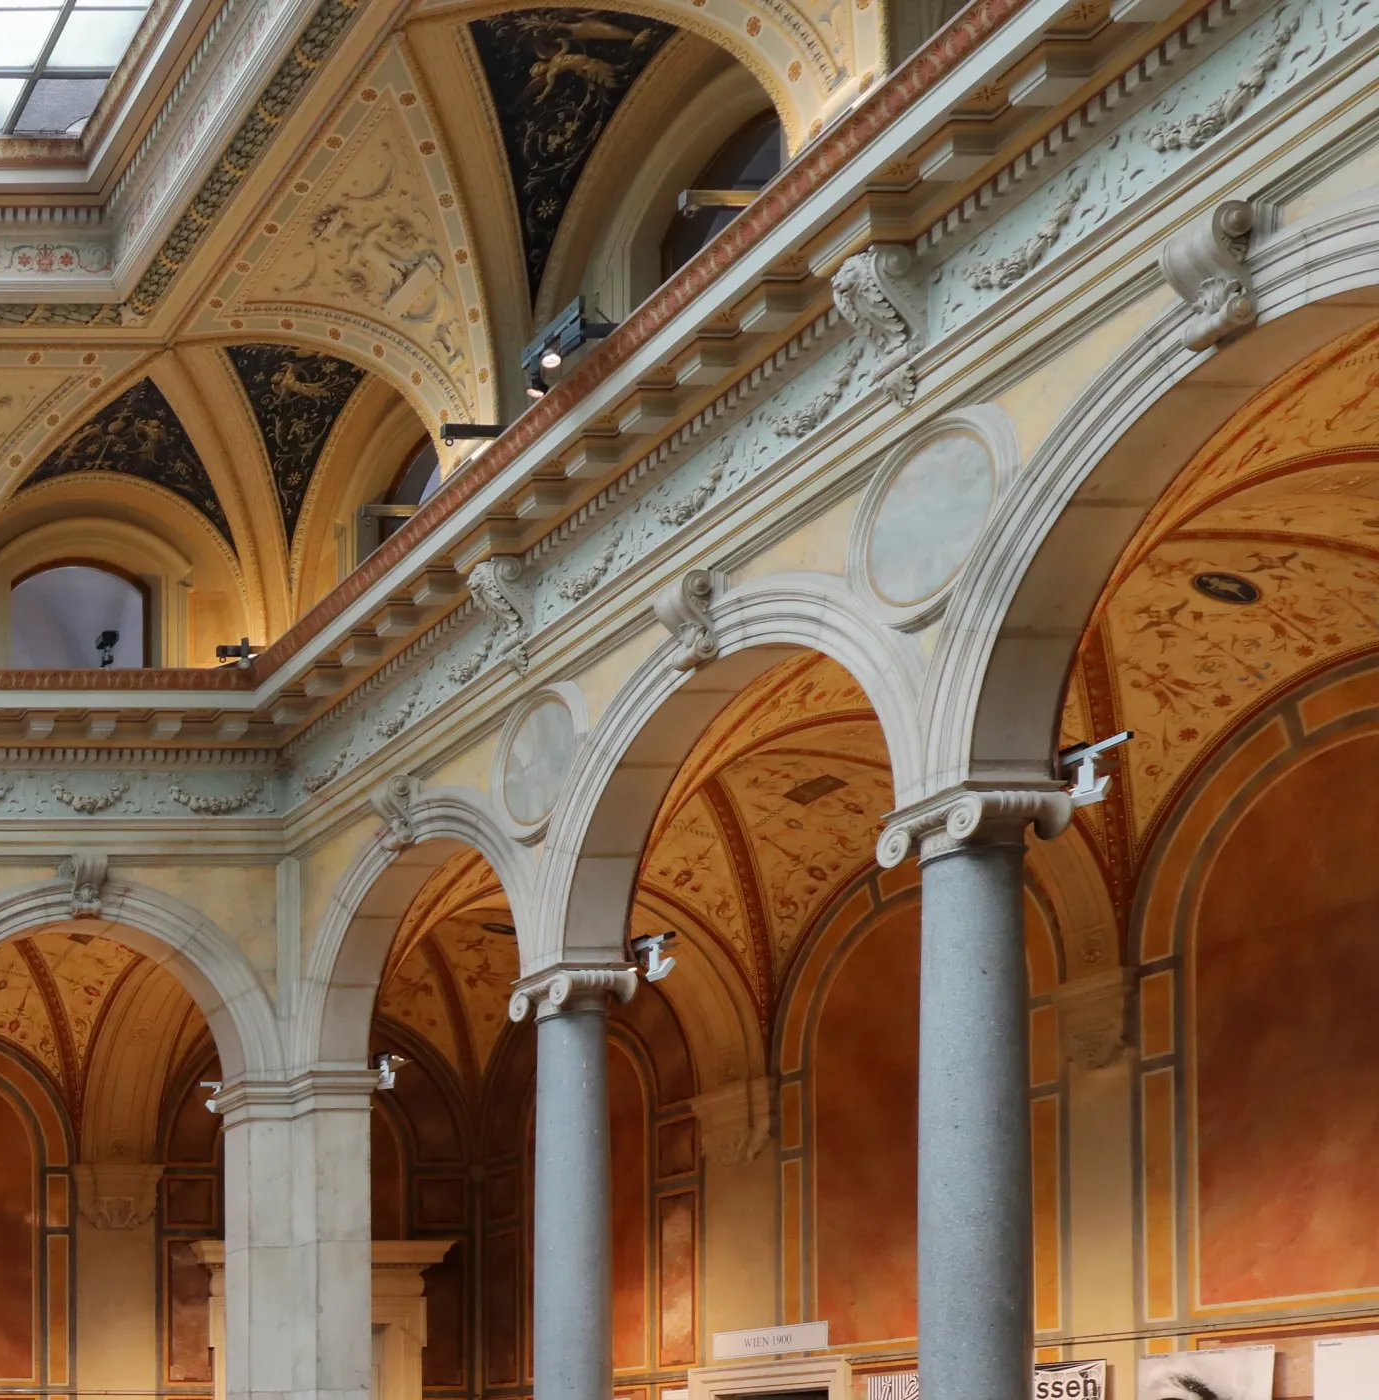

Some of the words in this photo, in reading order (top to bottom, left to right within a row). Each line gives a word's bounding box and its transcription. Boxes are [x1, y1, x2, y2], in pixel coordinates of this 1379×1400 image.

[743, 1336, 769, 1348] WIEN
[772, 1334, 792, 1346] 1900
[1036, 1376, 1098, 1399] ssen
